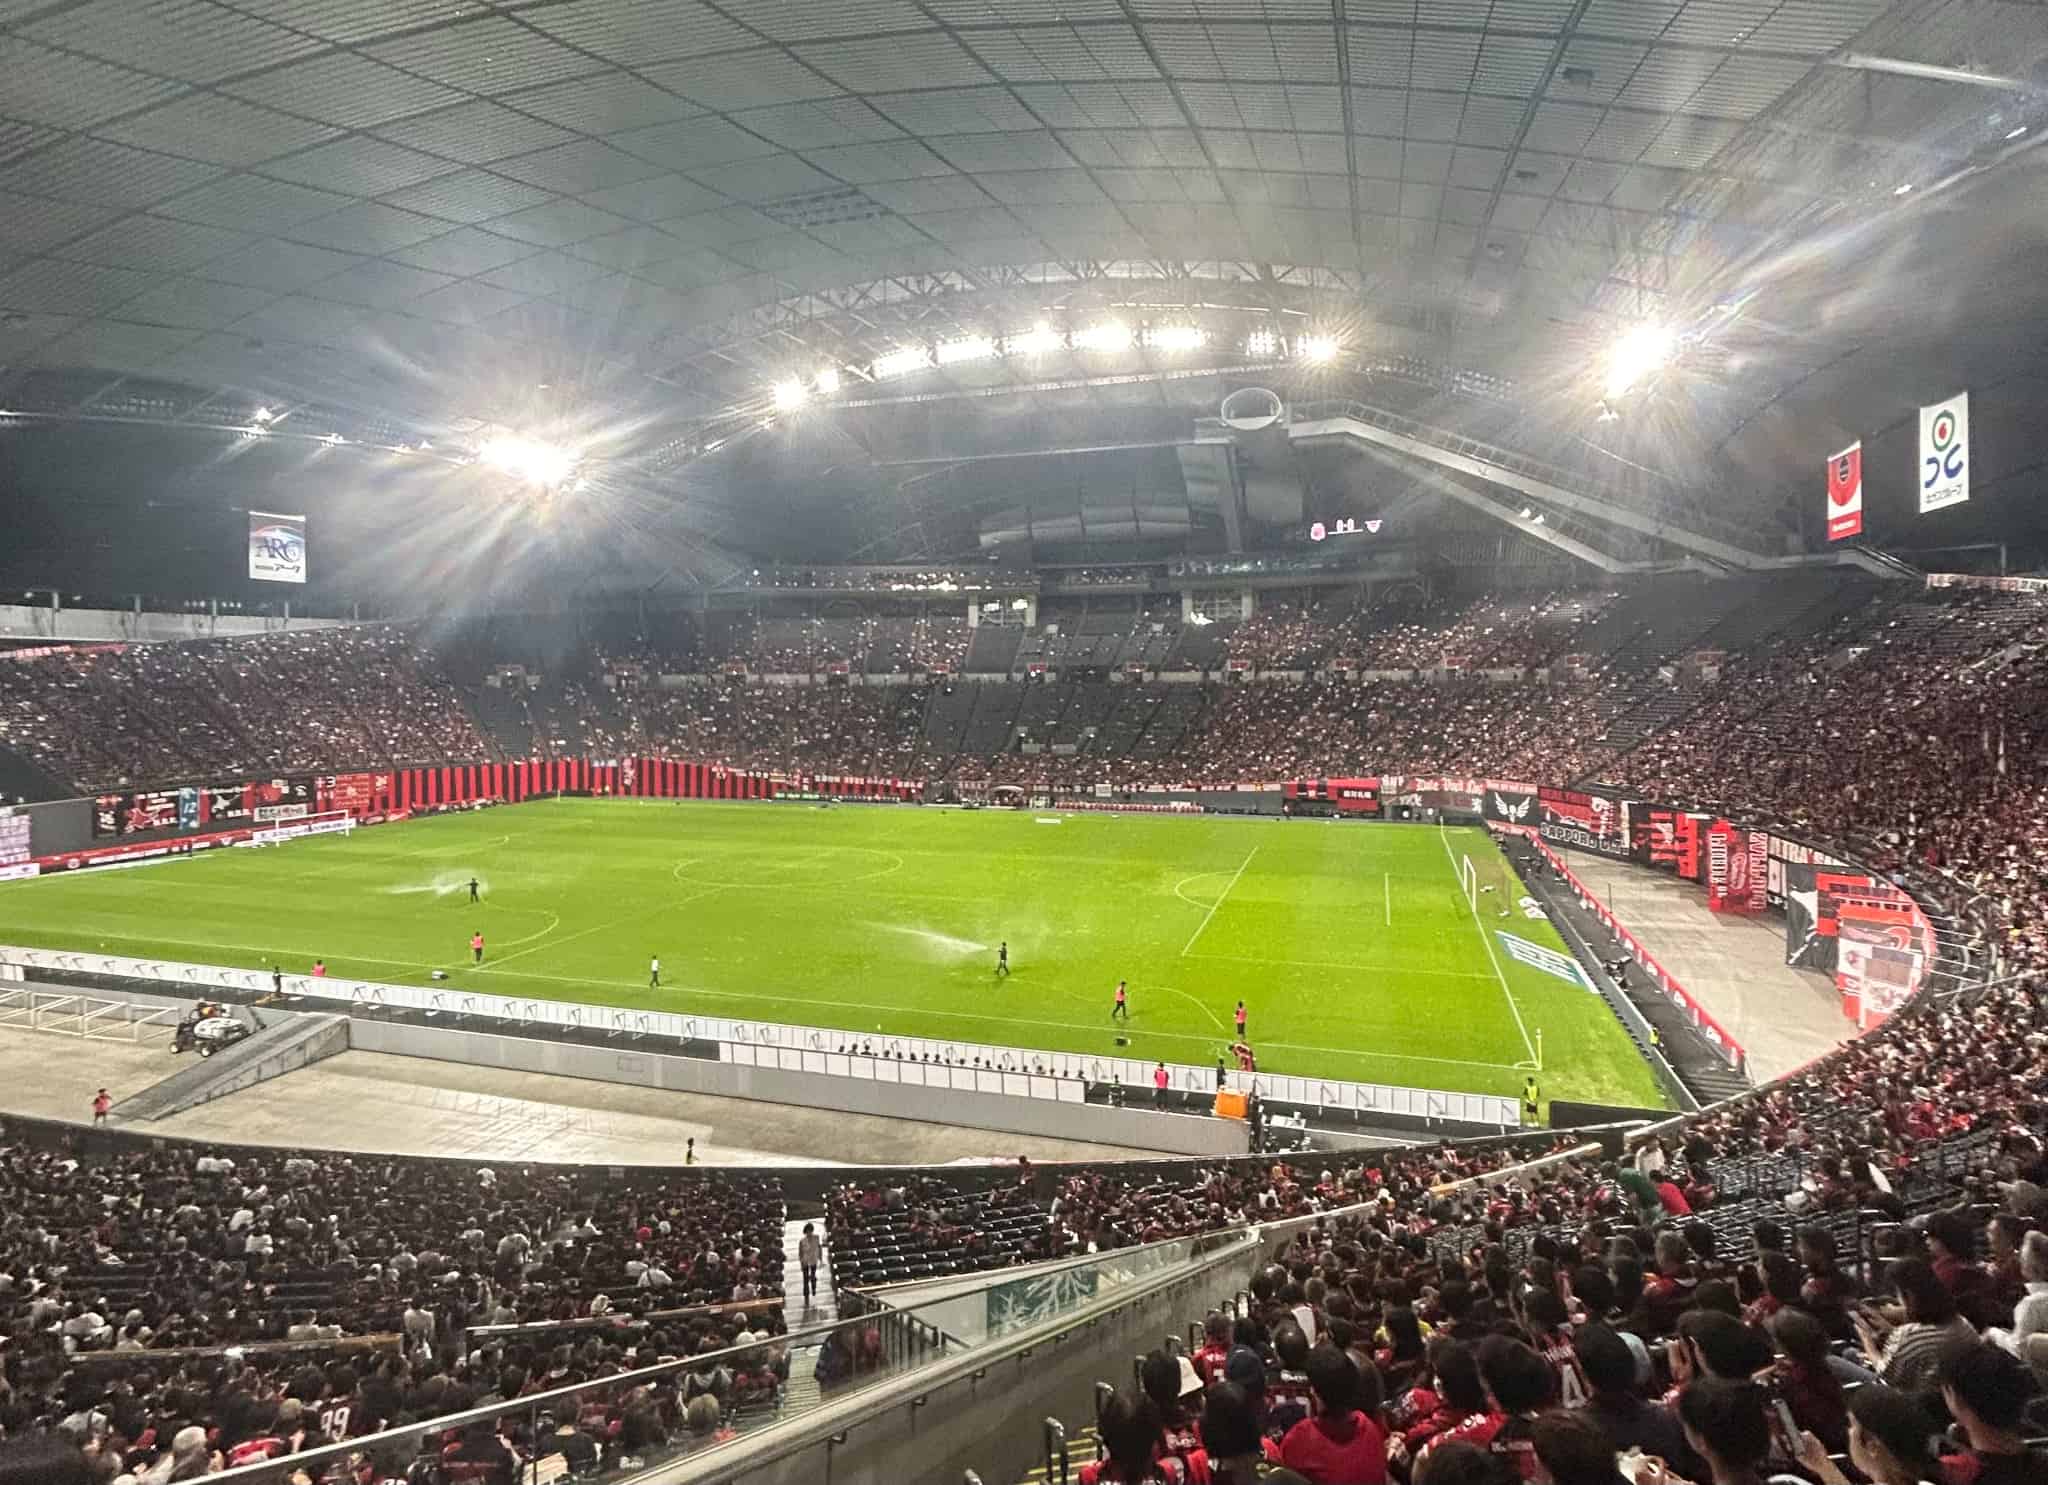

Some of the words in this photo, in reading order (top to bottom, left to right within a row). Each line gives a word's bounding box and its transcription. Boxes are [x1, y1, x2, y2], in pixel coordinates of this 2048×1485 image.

[1540, 822, 1597, 848] SAPPORO
[1562, 1364, 1588, 1409] 4
[320, 1407, 351, 1442] 99
